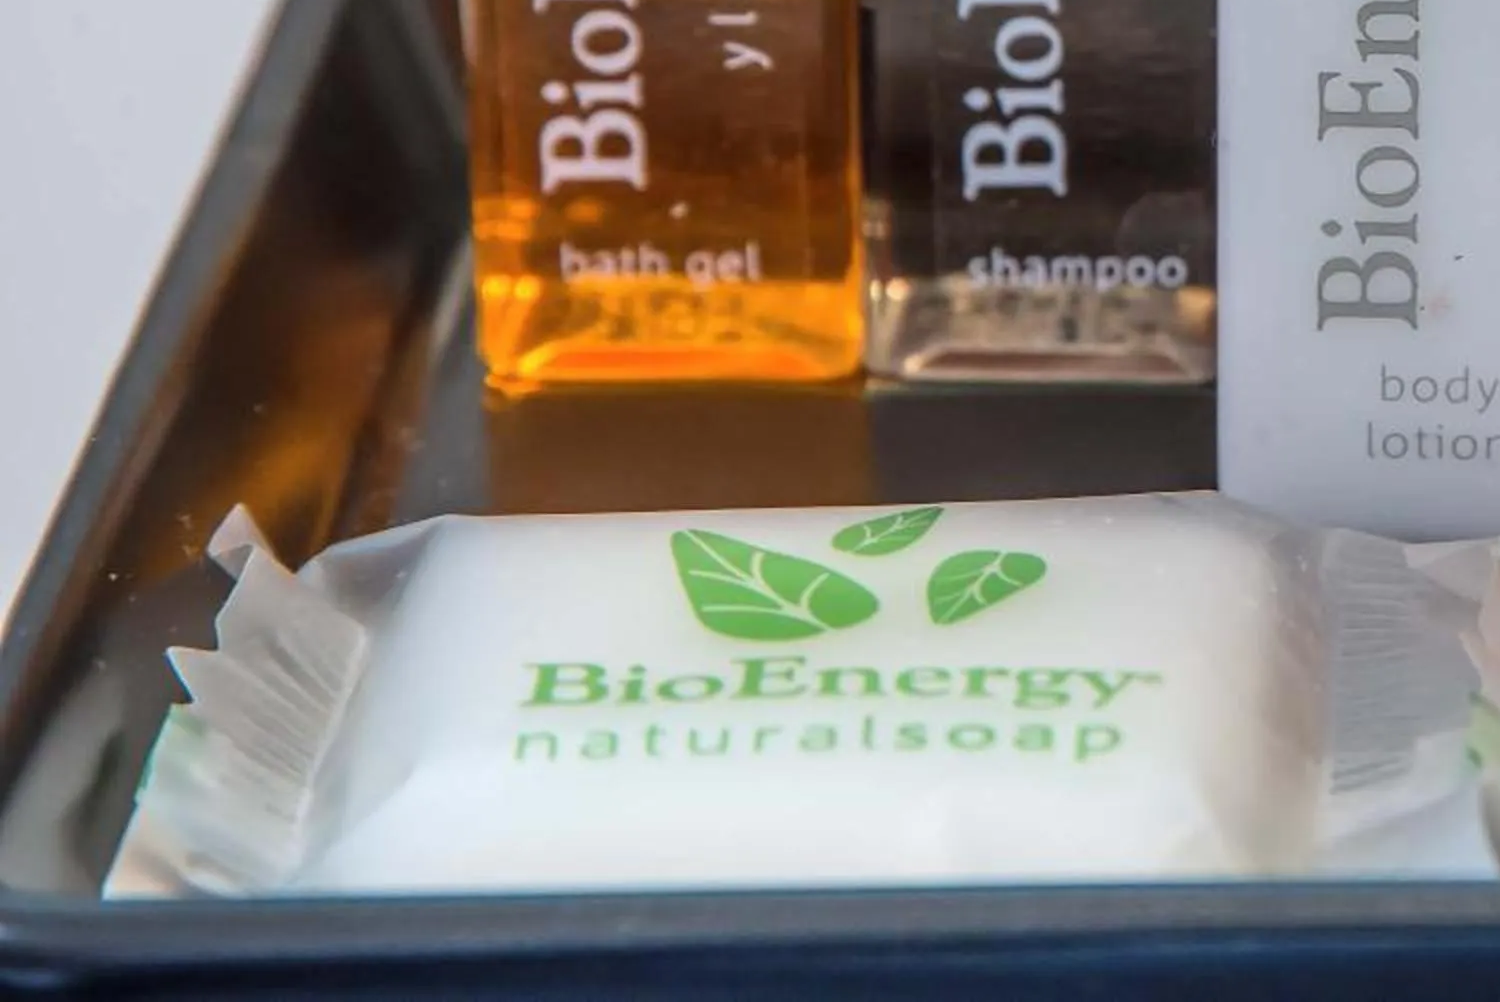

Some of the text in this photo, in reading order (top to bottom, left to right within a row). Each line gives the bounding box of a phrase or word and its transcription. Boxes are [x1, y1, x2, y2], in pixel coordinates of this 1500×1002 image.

[560, 240, 762, 292] bath gel
[967, 247, 1188, 292] shampoo
[1380, 364, 1499, 411] body
